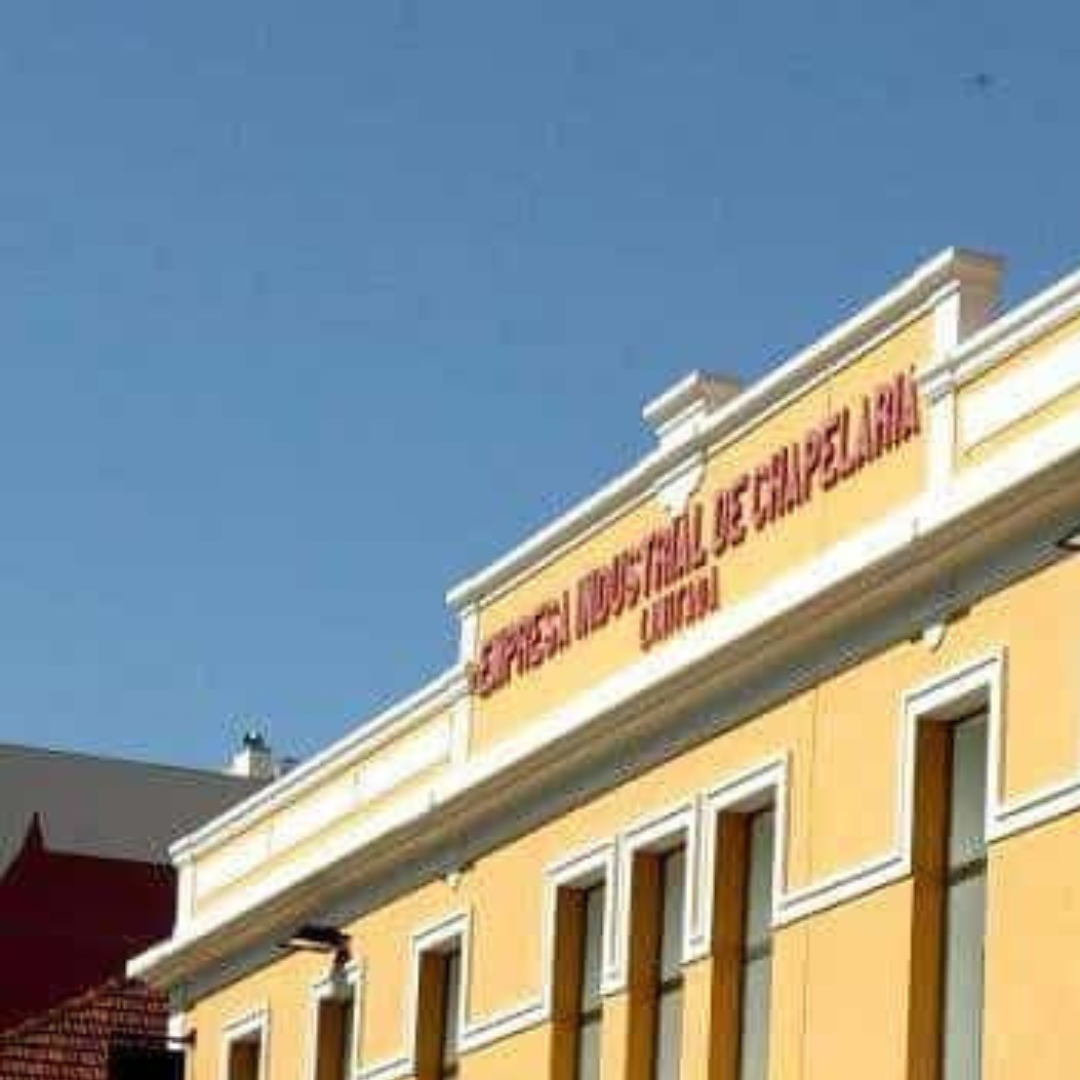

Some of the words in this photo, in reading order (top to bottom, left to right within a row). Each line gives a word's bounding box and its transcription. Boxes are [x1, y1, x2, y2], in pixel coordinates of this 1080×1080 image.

[472, 590, 571, 698] EMPRESA
[575, 503, 708, 641] INDUSTRIAL
[714, 475, 749, 557] DE
[753, 371, 921, 532] CHAPELARIA
